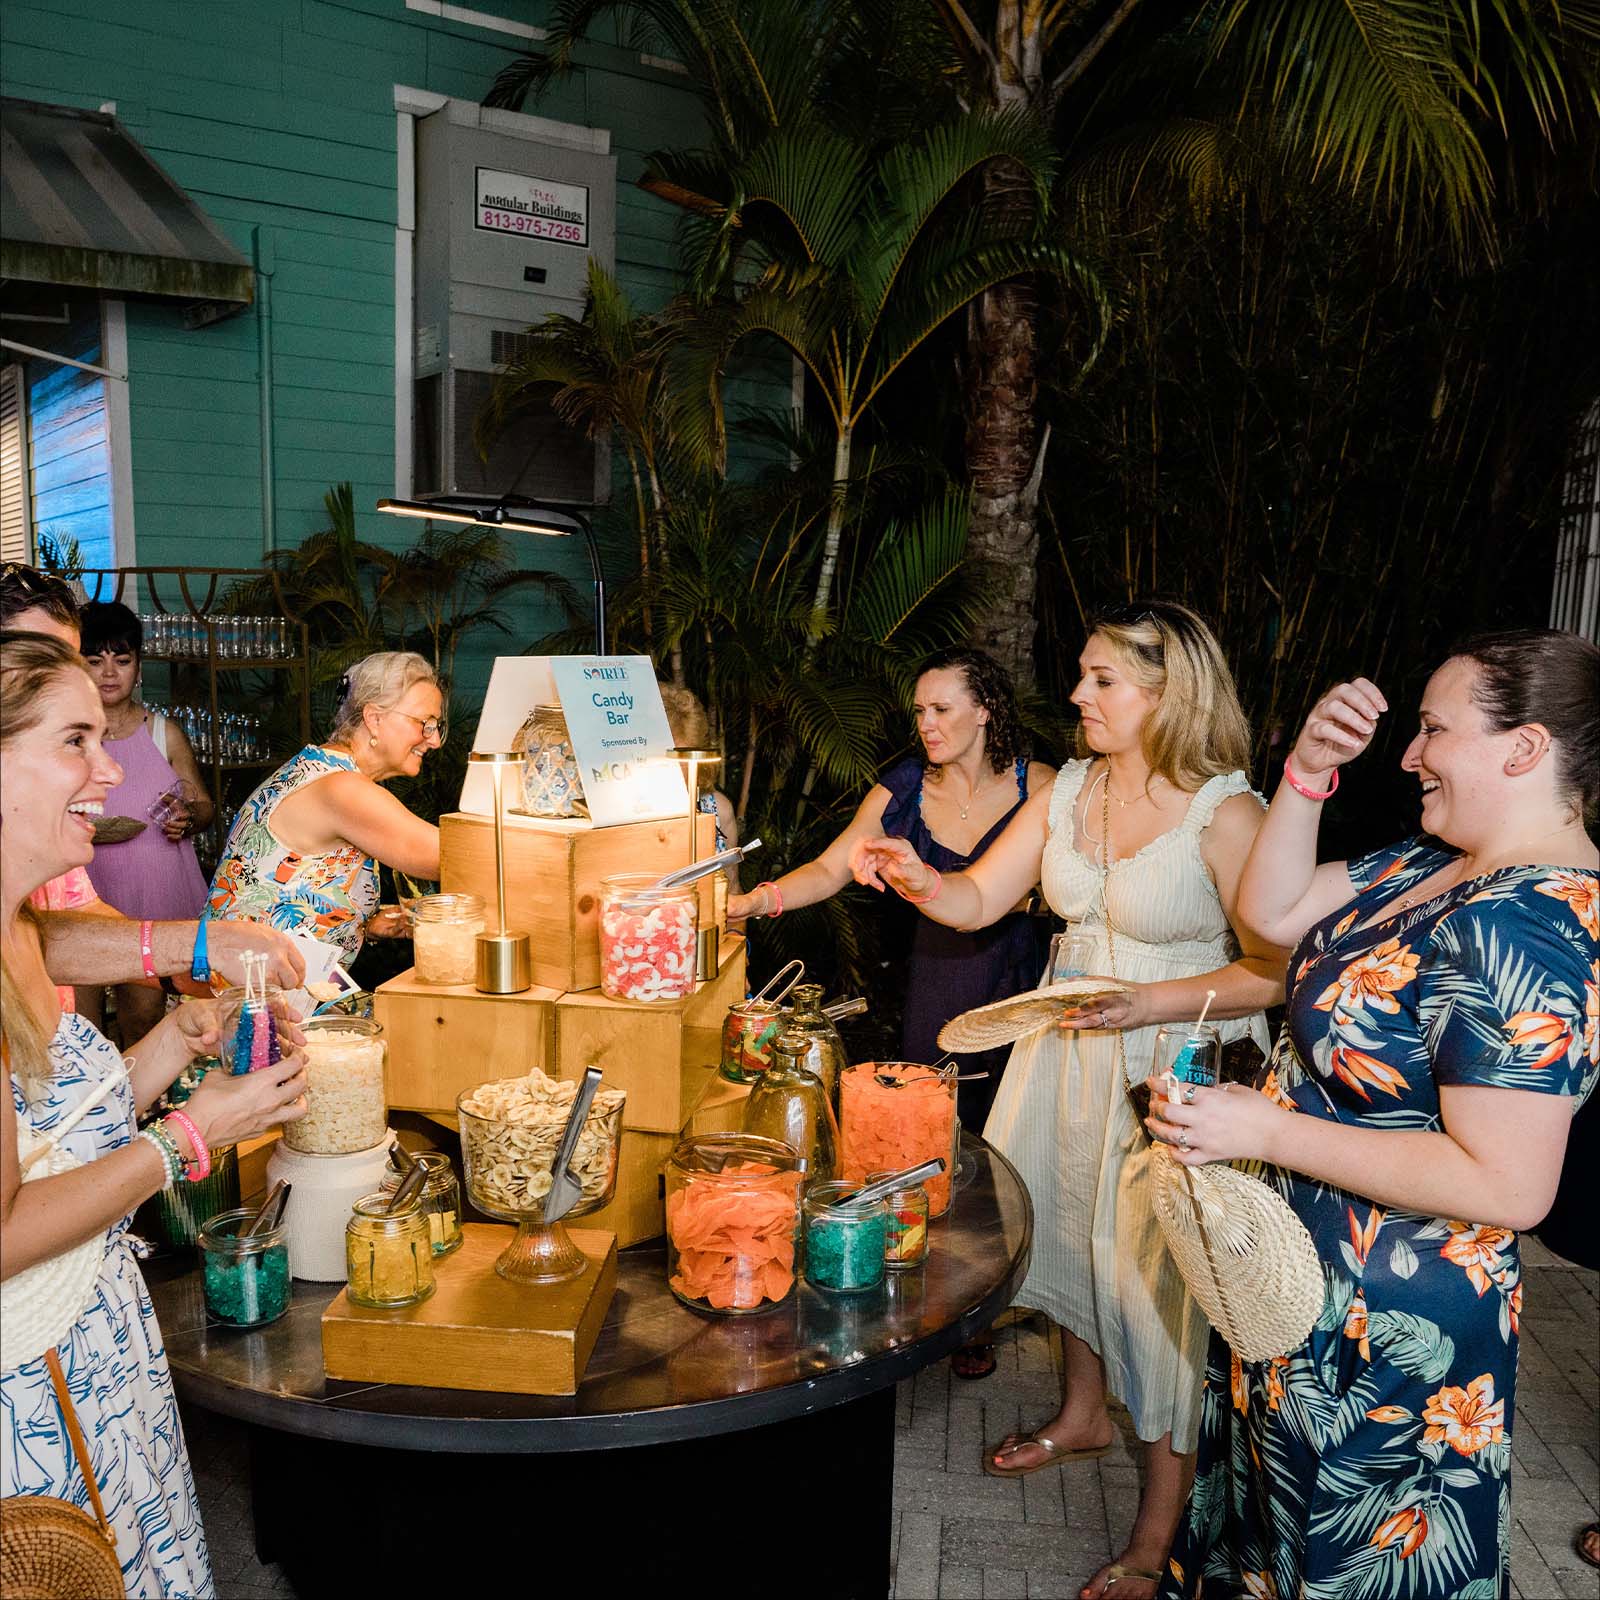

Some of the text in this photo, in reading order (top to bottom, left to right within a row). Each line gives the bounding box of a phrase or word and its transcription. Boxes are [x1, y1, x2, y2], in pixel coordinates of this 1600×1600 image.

[532, 200, 582, 222] Buildings
[484, 211, 581, 241] 813-975-7256
[592, 691, 634, 710] Candy
[606, 711, 629, 725] Bar
[601, 736, 647, 747] Sponsored By
